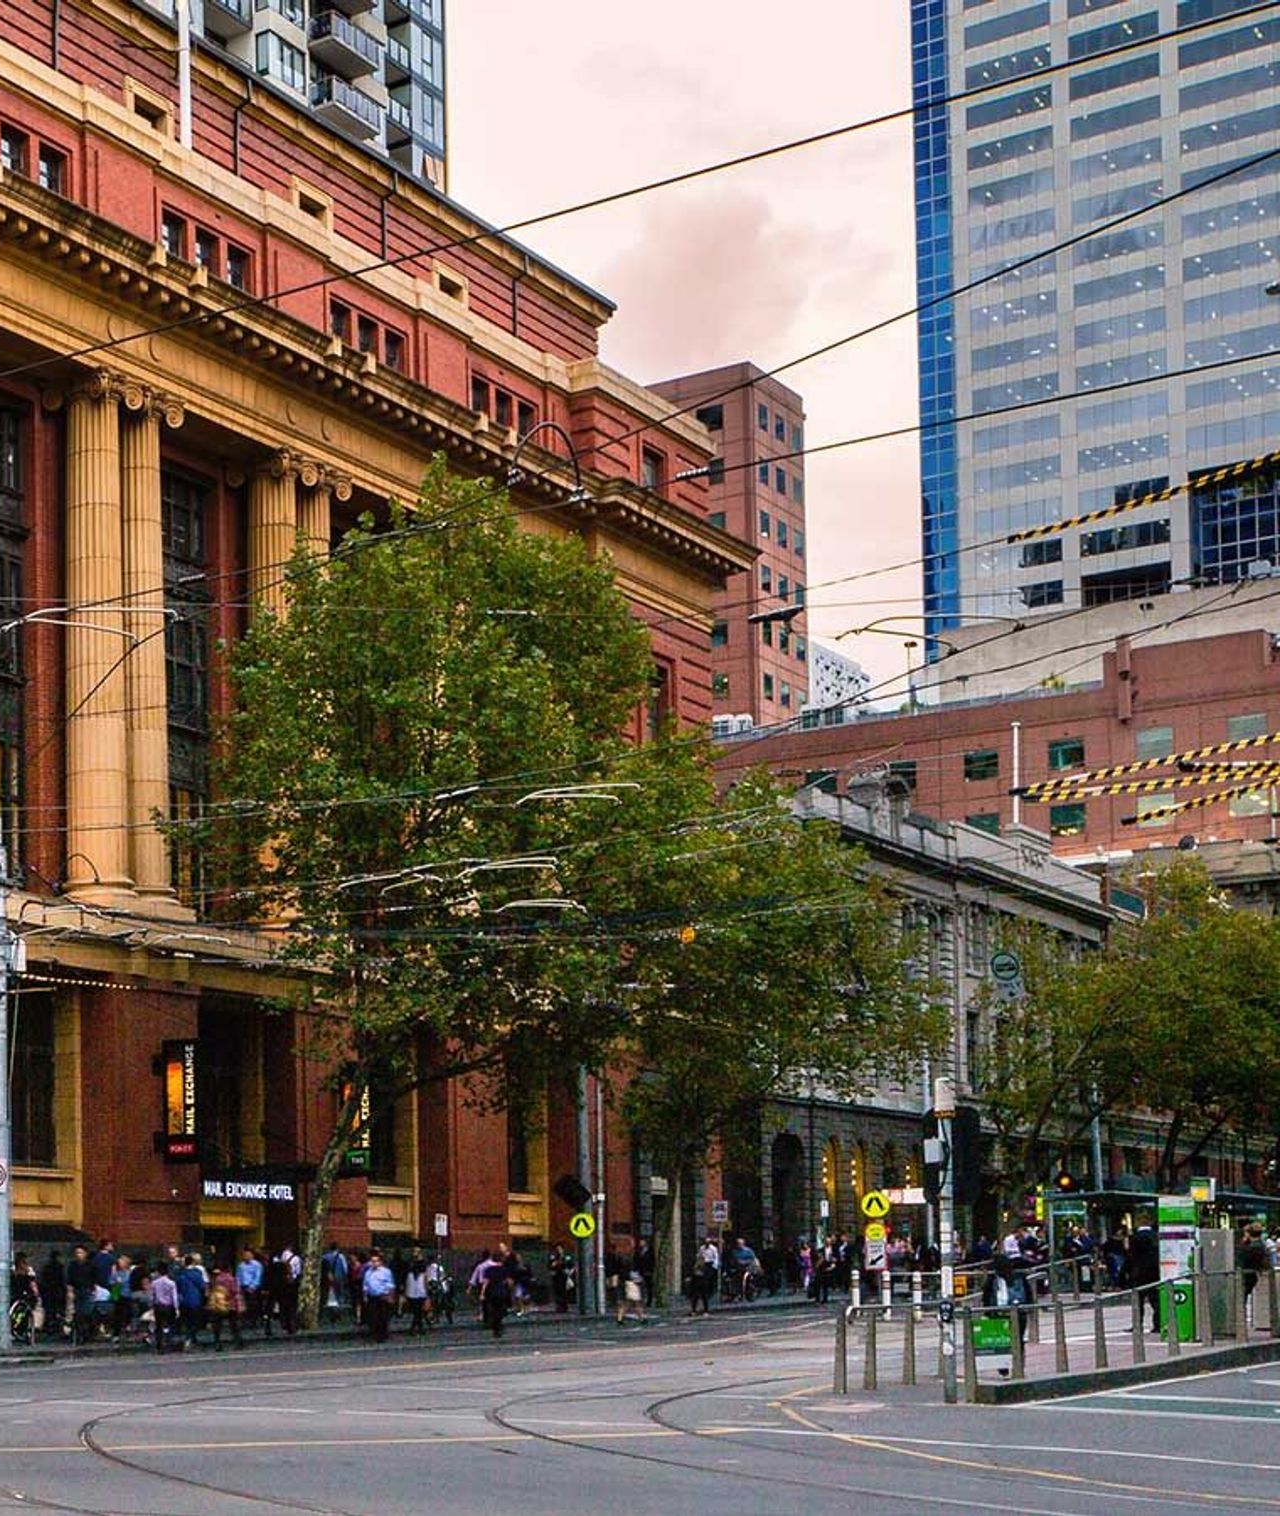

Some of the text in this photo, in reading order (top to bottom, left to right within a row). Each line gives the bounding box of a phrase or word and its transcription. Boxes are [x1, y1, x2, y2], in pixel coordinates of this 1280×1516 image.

[184, 1043, 195, 1135] MAIL EXCHANGE
[203, 1180, 294, 1201] MAIL EXCHANGE HOTEL
